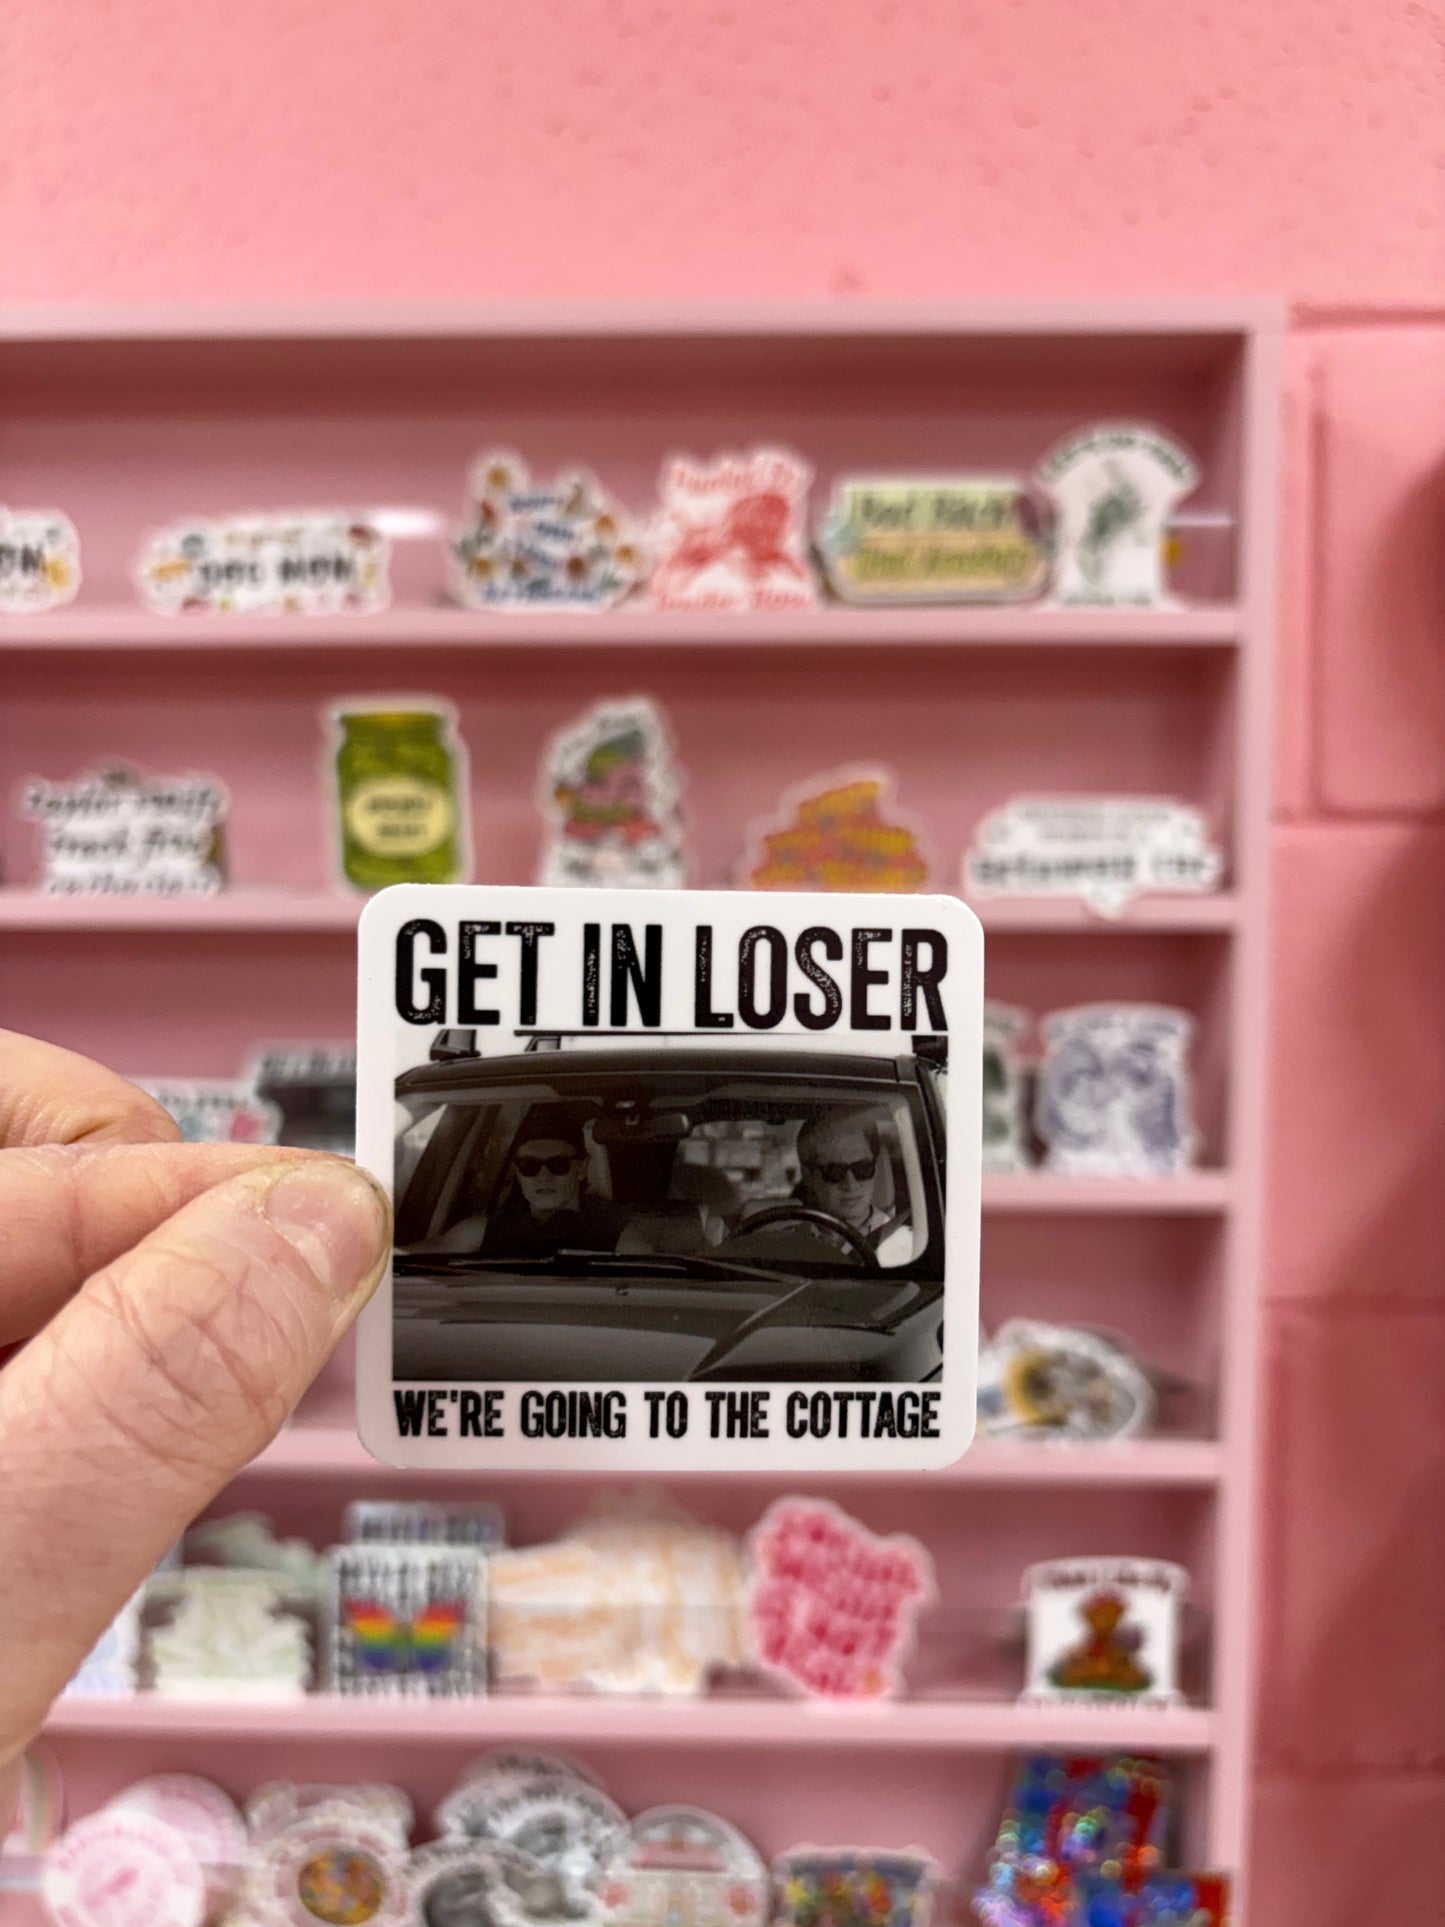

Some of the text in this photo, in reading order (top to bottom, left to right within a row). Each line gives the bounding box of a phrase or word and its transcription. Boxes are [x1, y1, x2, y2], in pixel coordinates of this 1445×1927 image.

[395, 918, 949, 1031] GET IN LOSER
[393, 1389, 942, 1439] WE'RE GOING TO THE COTTAGE
